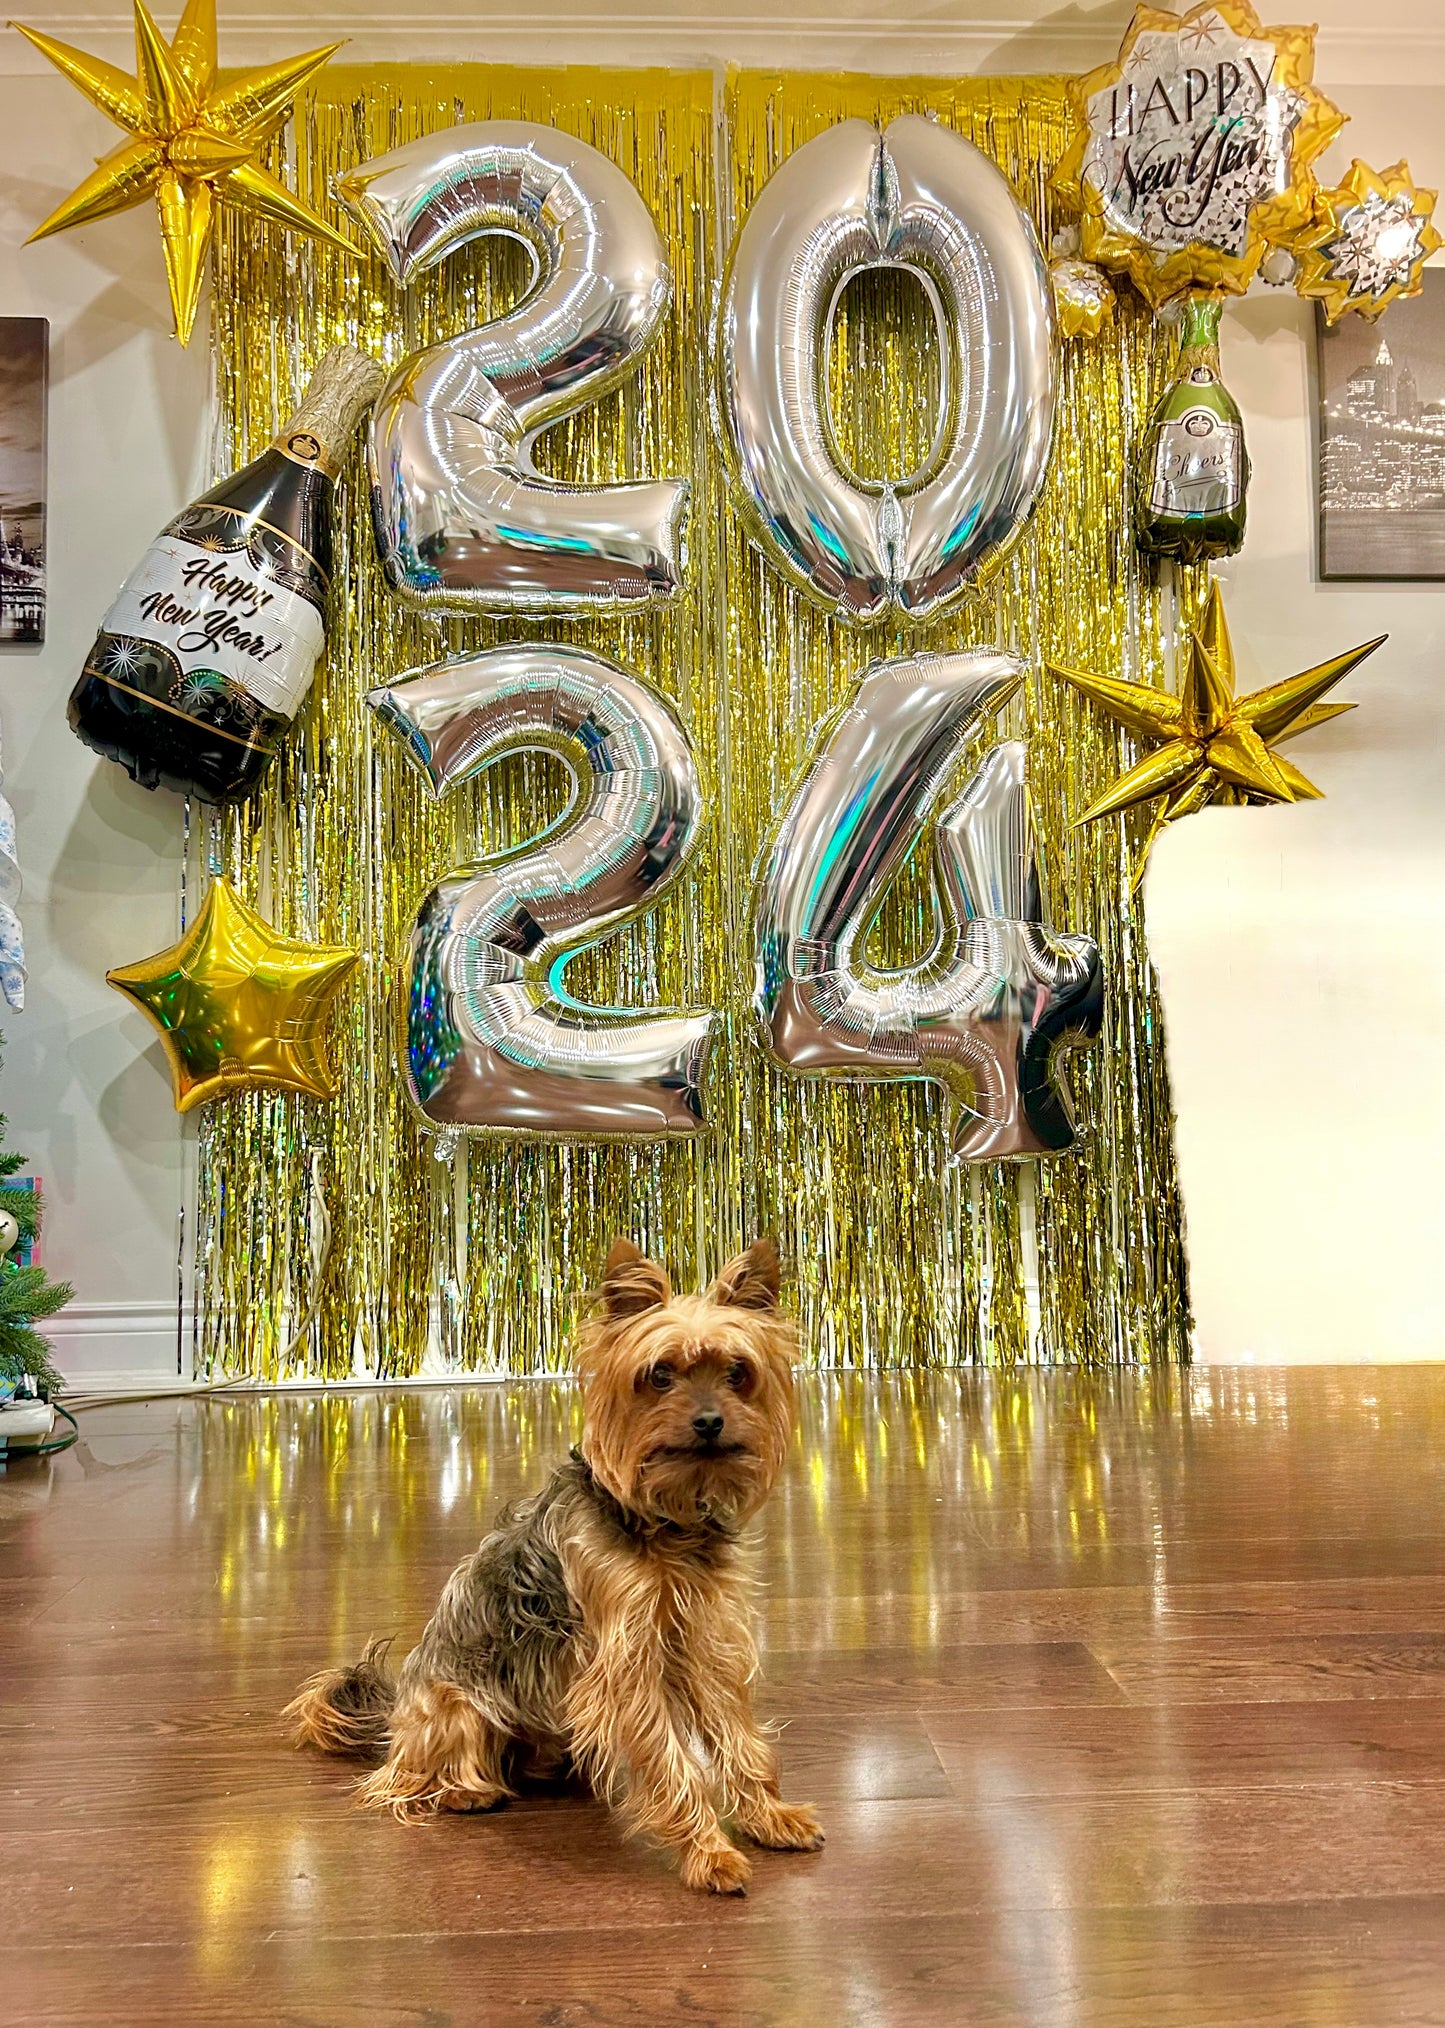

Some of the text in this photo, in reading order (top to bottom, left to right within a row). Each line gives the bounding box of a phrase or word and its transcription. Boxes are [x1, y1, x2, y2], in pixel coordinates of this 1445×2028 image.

[1109, 54, 1278, 140] HAPPY
[1081, 139, 1182, 217] New
[181, 558, 274, 618] Happy
[140, 592, 283, 662] New Year!
